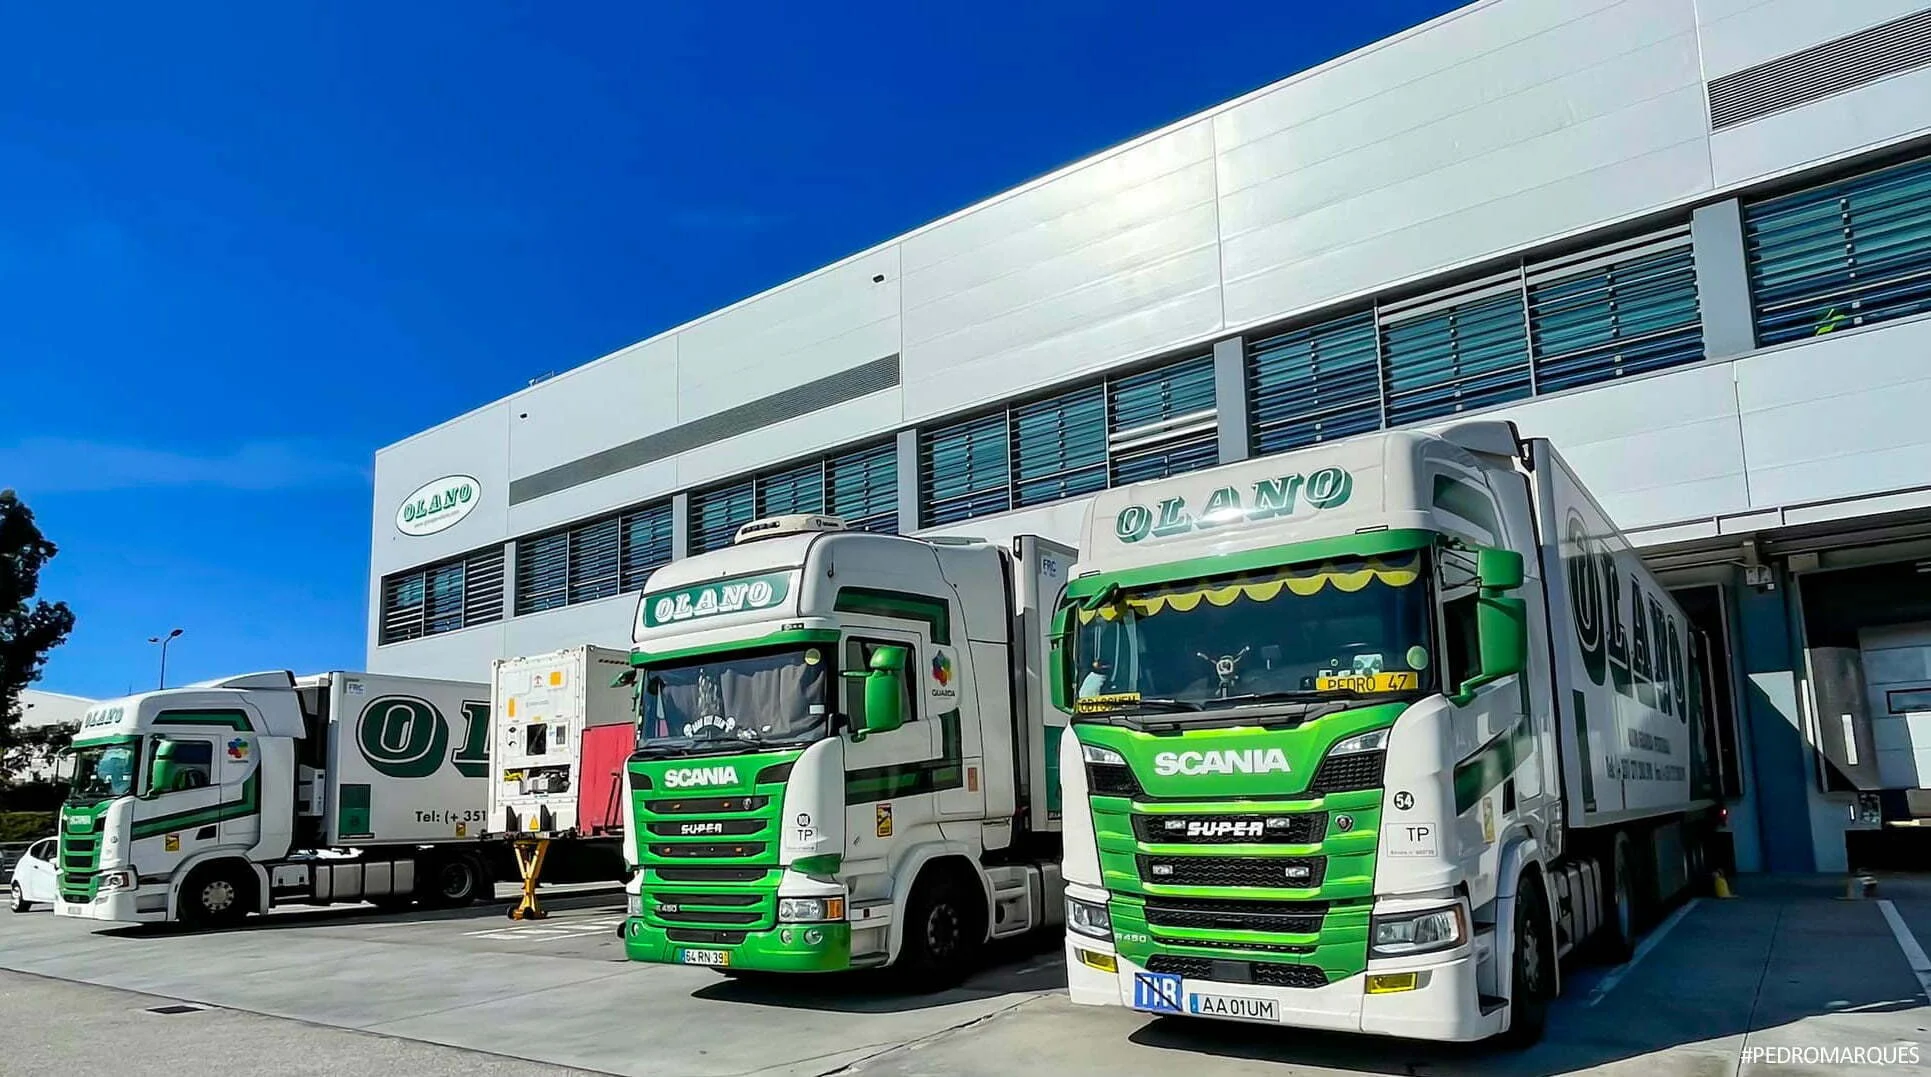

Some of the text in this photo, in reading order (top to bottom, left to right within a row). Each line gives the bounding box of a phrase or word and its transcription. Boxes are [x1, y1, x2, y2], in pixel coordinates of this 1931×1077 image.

[404, 483, 472, 522] OLANO
[1115, 465, 1353, 543] OLANO
[655, 581, 773, 623] OLANO
[1565, 506, 1687, 725] OLANO
[1387, 674, 1408, 690] 47
[85, 706, 124, 728] OLANO
[1154, 748, 1291, 776] SCANIA
[664, 766, 739, 788] SCANIA
[1396, 794, 1412, 808] 54
[415, 810, 440, 822] Tel:
[464, 810, 486, 821] 351
[680, 823, 722, 835] SUPER
[797, 829, 813, 841] TP
[1187, 821, 1264, 836] SUPER
[1406, 827, 1429, 841] TP
[1137, 976, 1178, 1008] TIR
